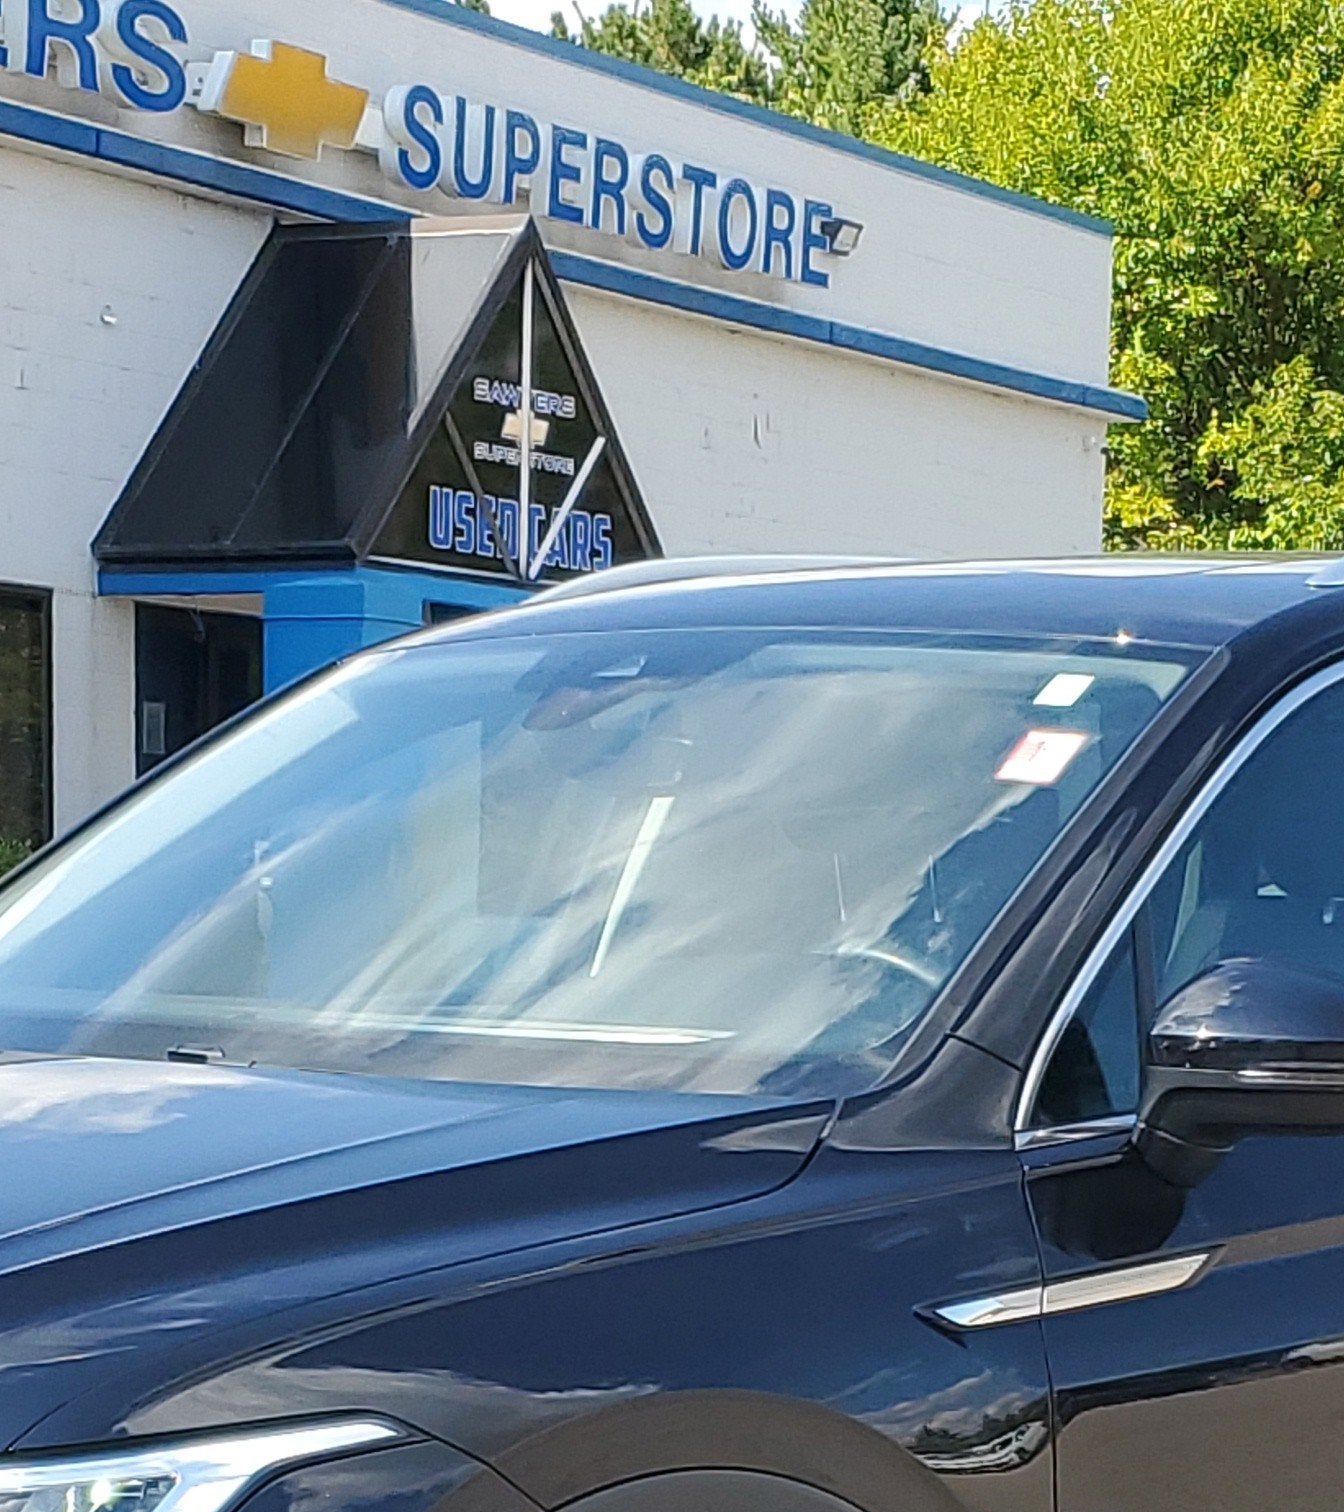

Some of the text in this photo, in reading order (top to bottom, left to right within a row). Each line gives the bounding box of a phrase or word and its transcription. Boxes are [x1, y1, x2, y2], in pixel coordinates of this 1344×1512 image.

[397, 84, 834, 288] SUPERSTORE
[473, 376, 576, 419] SAWERS
[473, 441, 575, 476] SUPETORE
[429, 484, 521, 561] USED
